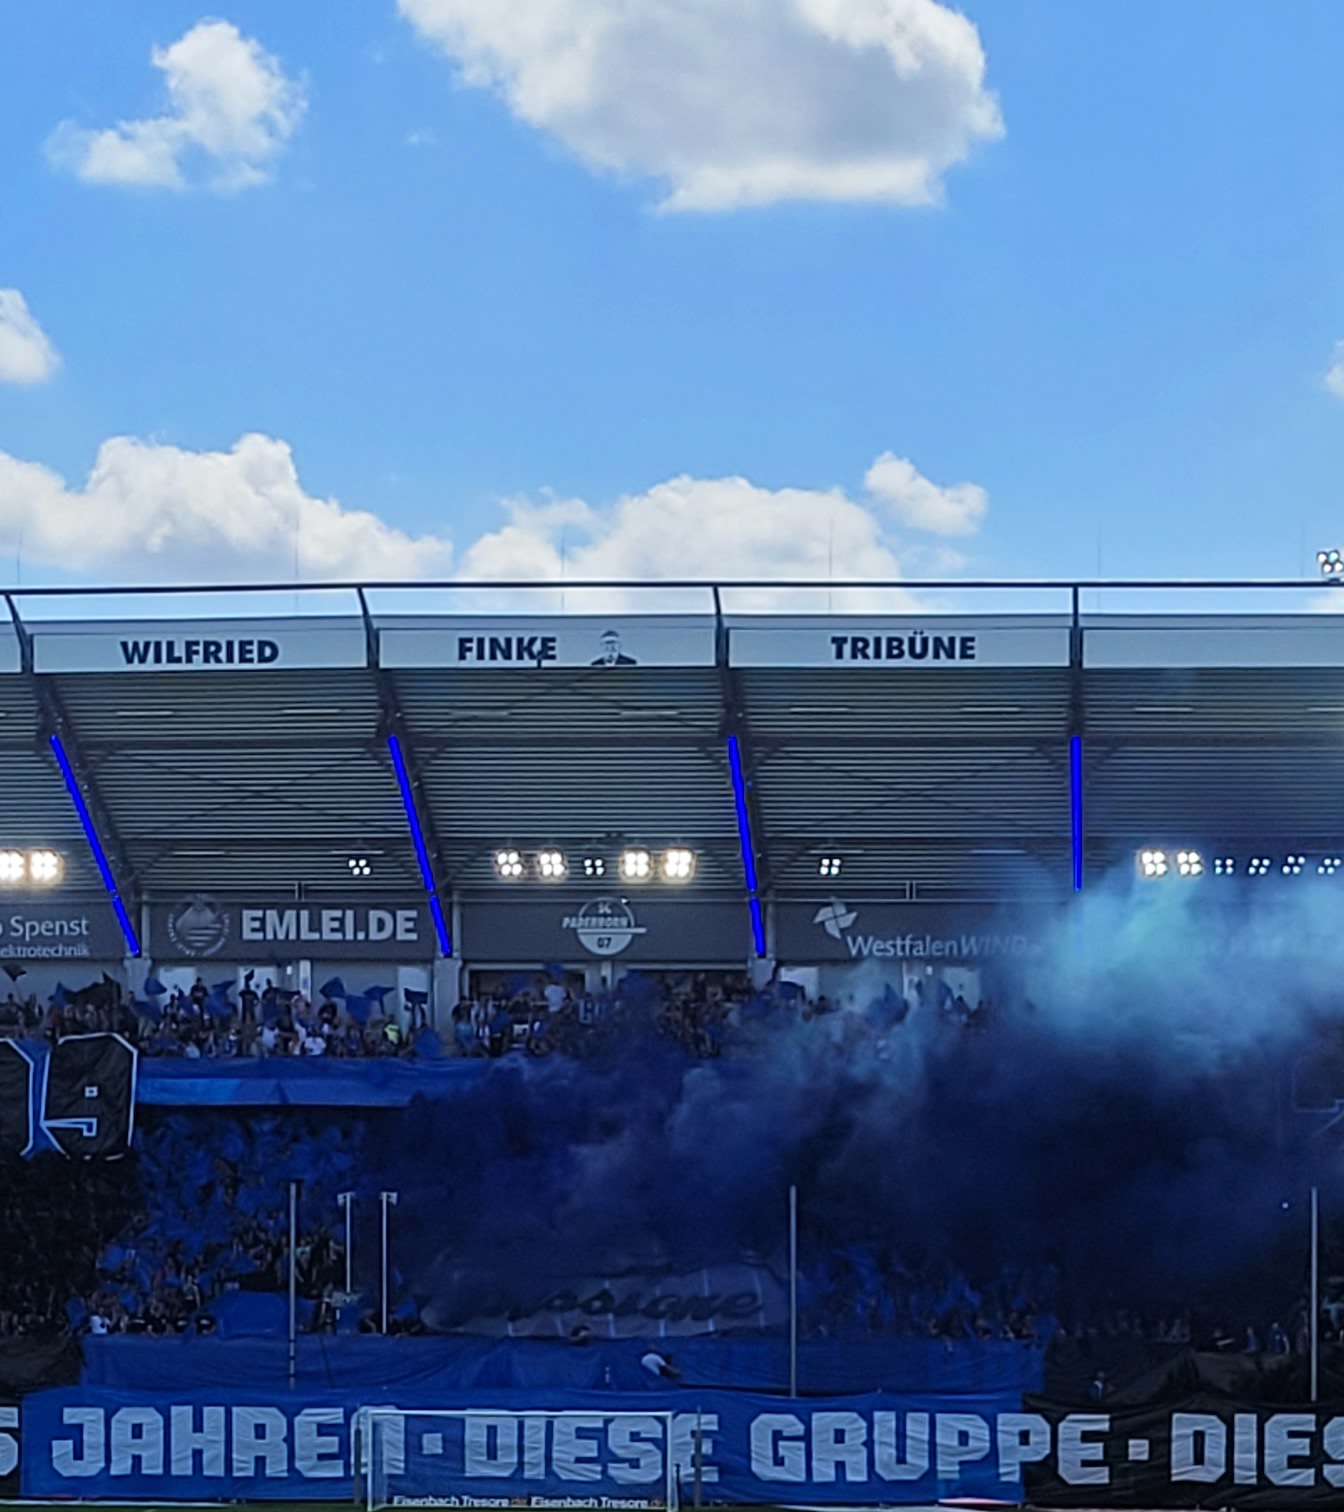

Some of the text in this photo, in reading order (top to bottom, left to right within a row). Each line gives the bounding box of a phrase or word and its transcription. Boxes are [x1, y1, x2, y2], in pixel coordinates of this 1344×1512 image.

[120, 638, 280, 665] WILFRIED
[457, 636, 558, 663] FINKE
[831, 630, 976, 661] TRIBÜNE
[10, 915, 90, 941] Spenst
[241, 909, 419, 941] EMLEI.DE
[51, 1404, 405, 1478] JAHREN
[464, 1407, 719, 1485] DIESE
[750, 1410, 1111, 1485] GRUPPE
